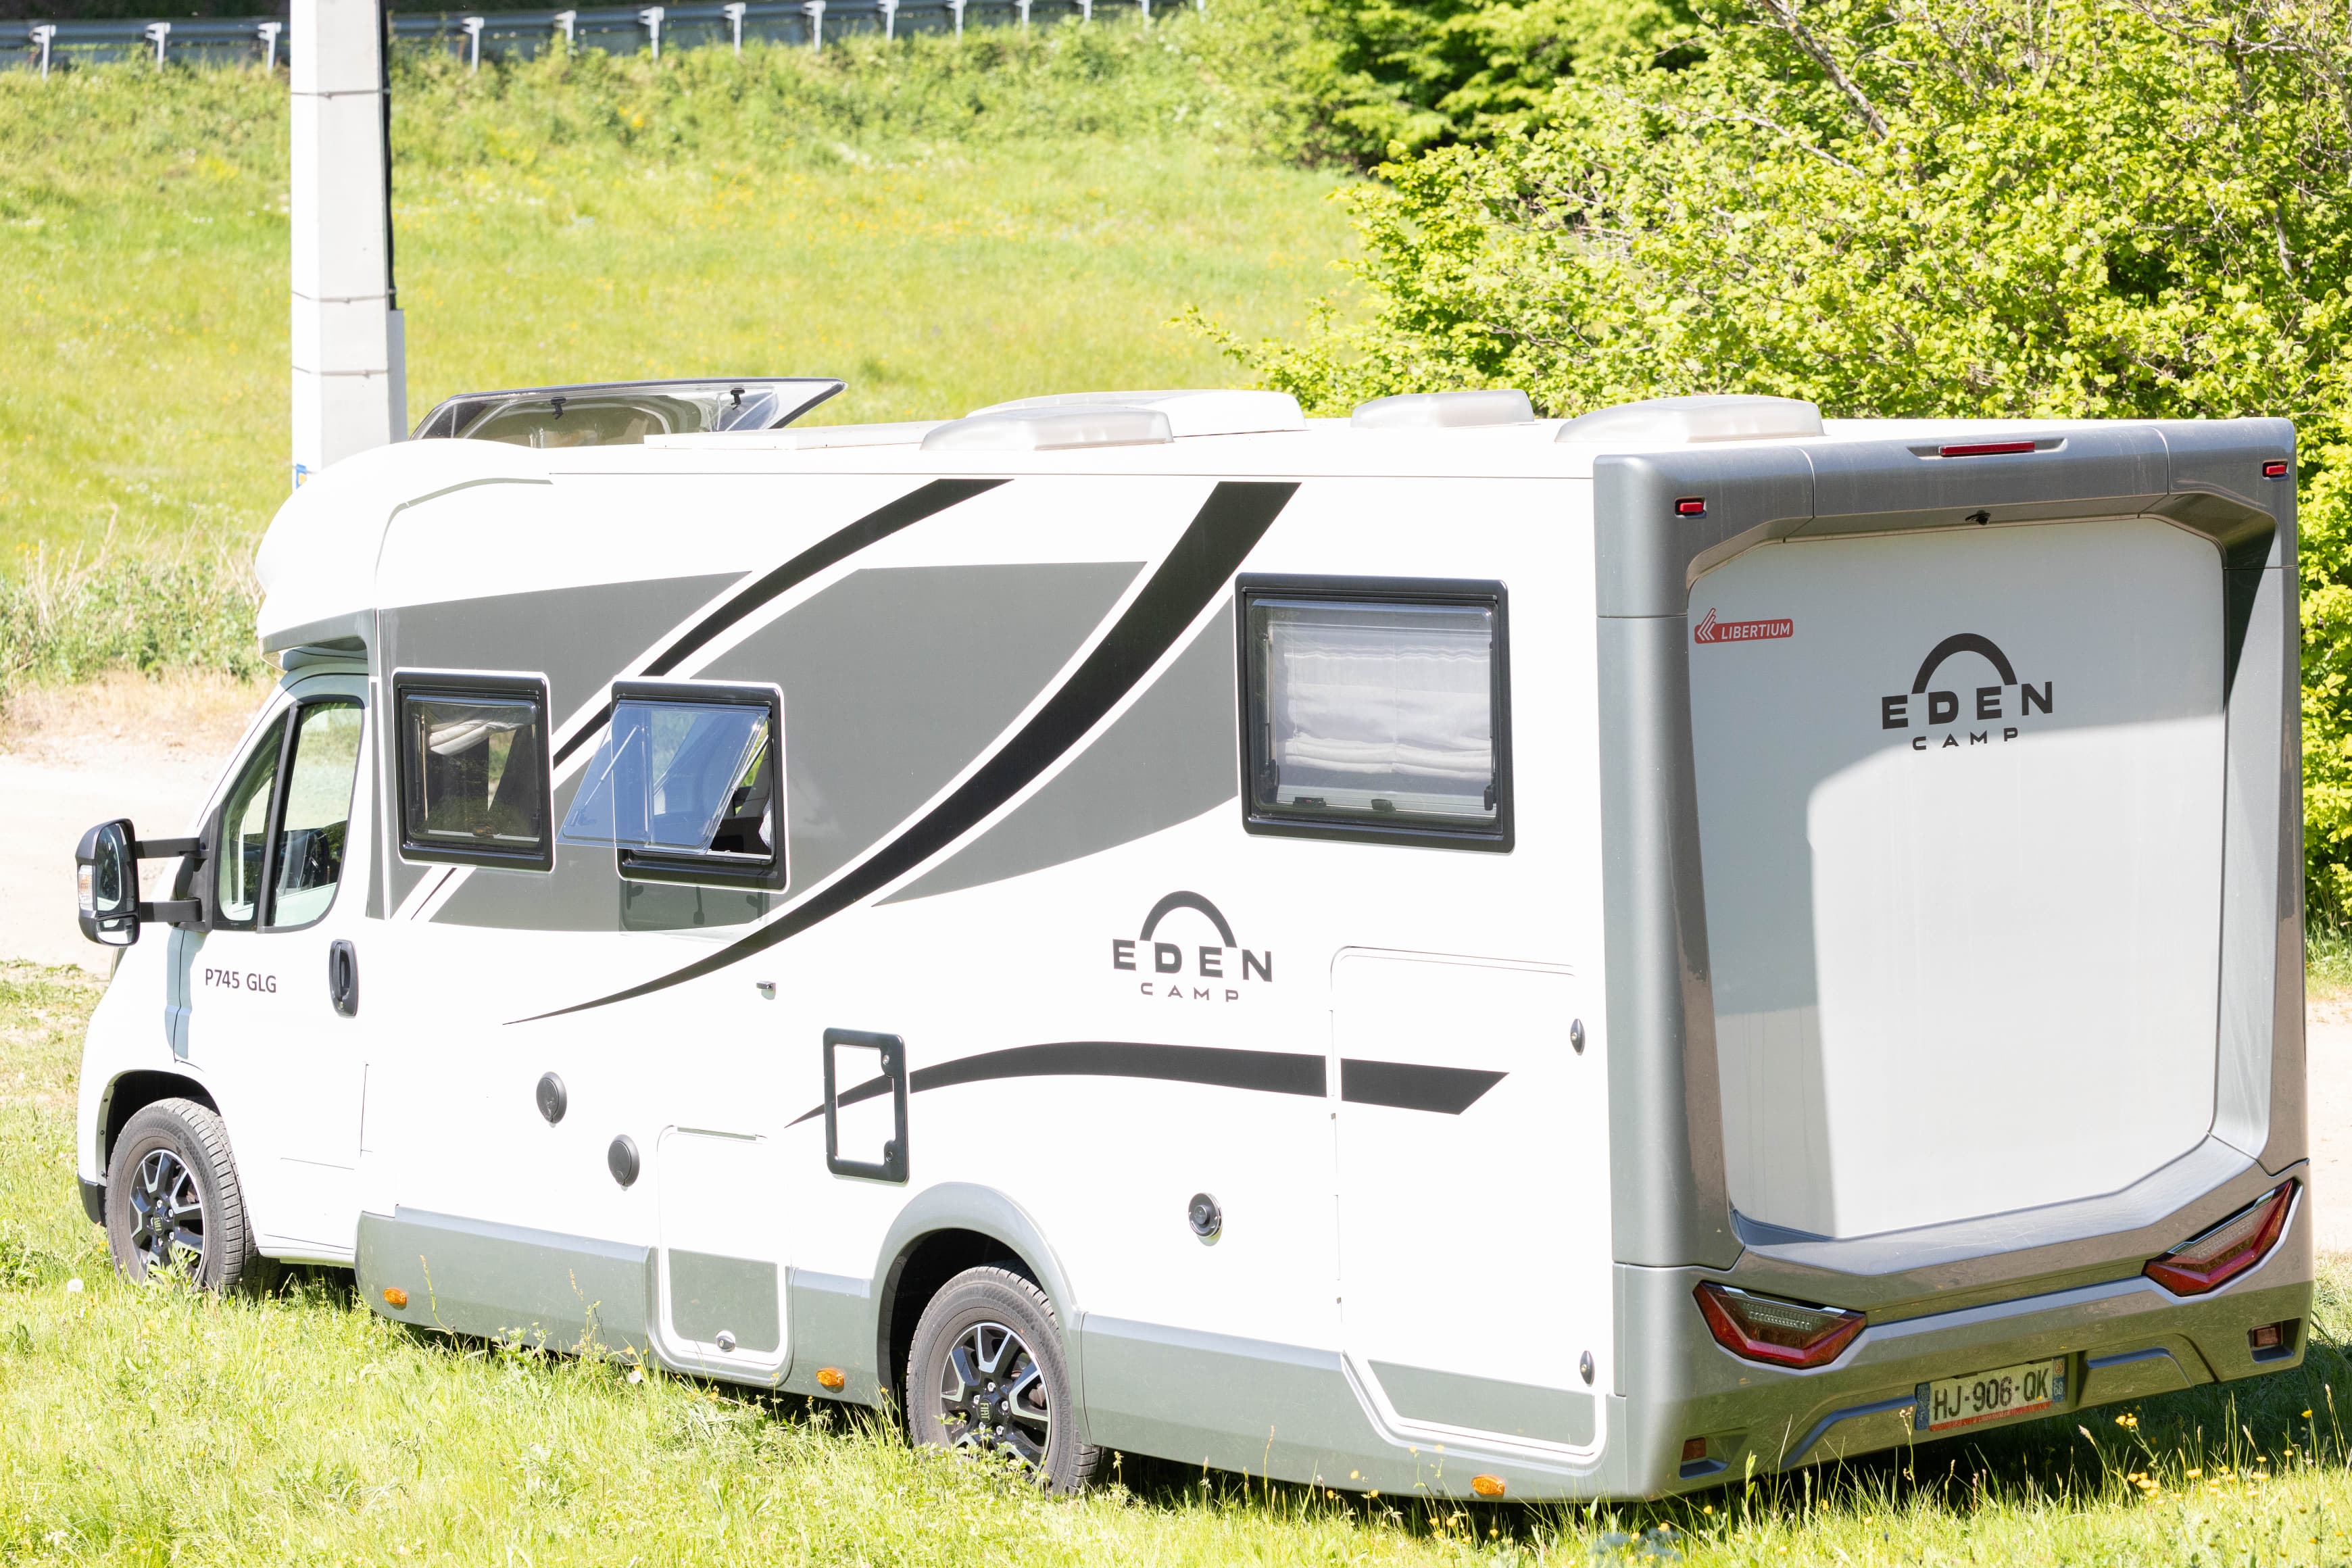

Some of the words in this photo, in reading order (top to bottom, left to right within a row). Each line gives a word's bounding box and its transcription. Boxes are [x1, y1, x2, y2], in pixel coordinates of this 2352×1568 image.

[1721, 622, 1791, 640] LIBERTIUM
[1881, 681, 2054, 730] EDEN
[1912, 727, 2019, 751] CAMP
[1112, 938, 1273, 983] EDEN
[205, 968, 240, 989] P745
[246, 973, 276, 994] GLG
[1140, 981, 1240, 1003] CAMP
[153, 1217, 162, 1231] FIAT
[1933, 1367, 2050, 1421] HJ-906-QK
[979, 1402, 990, 1420] FIAT
